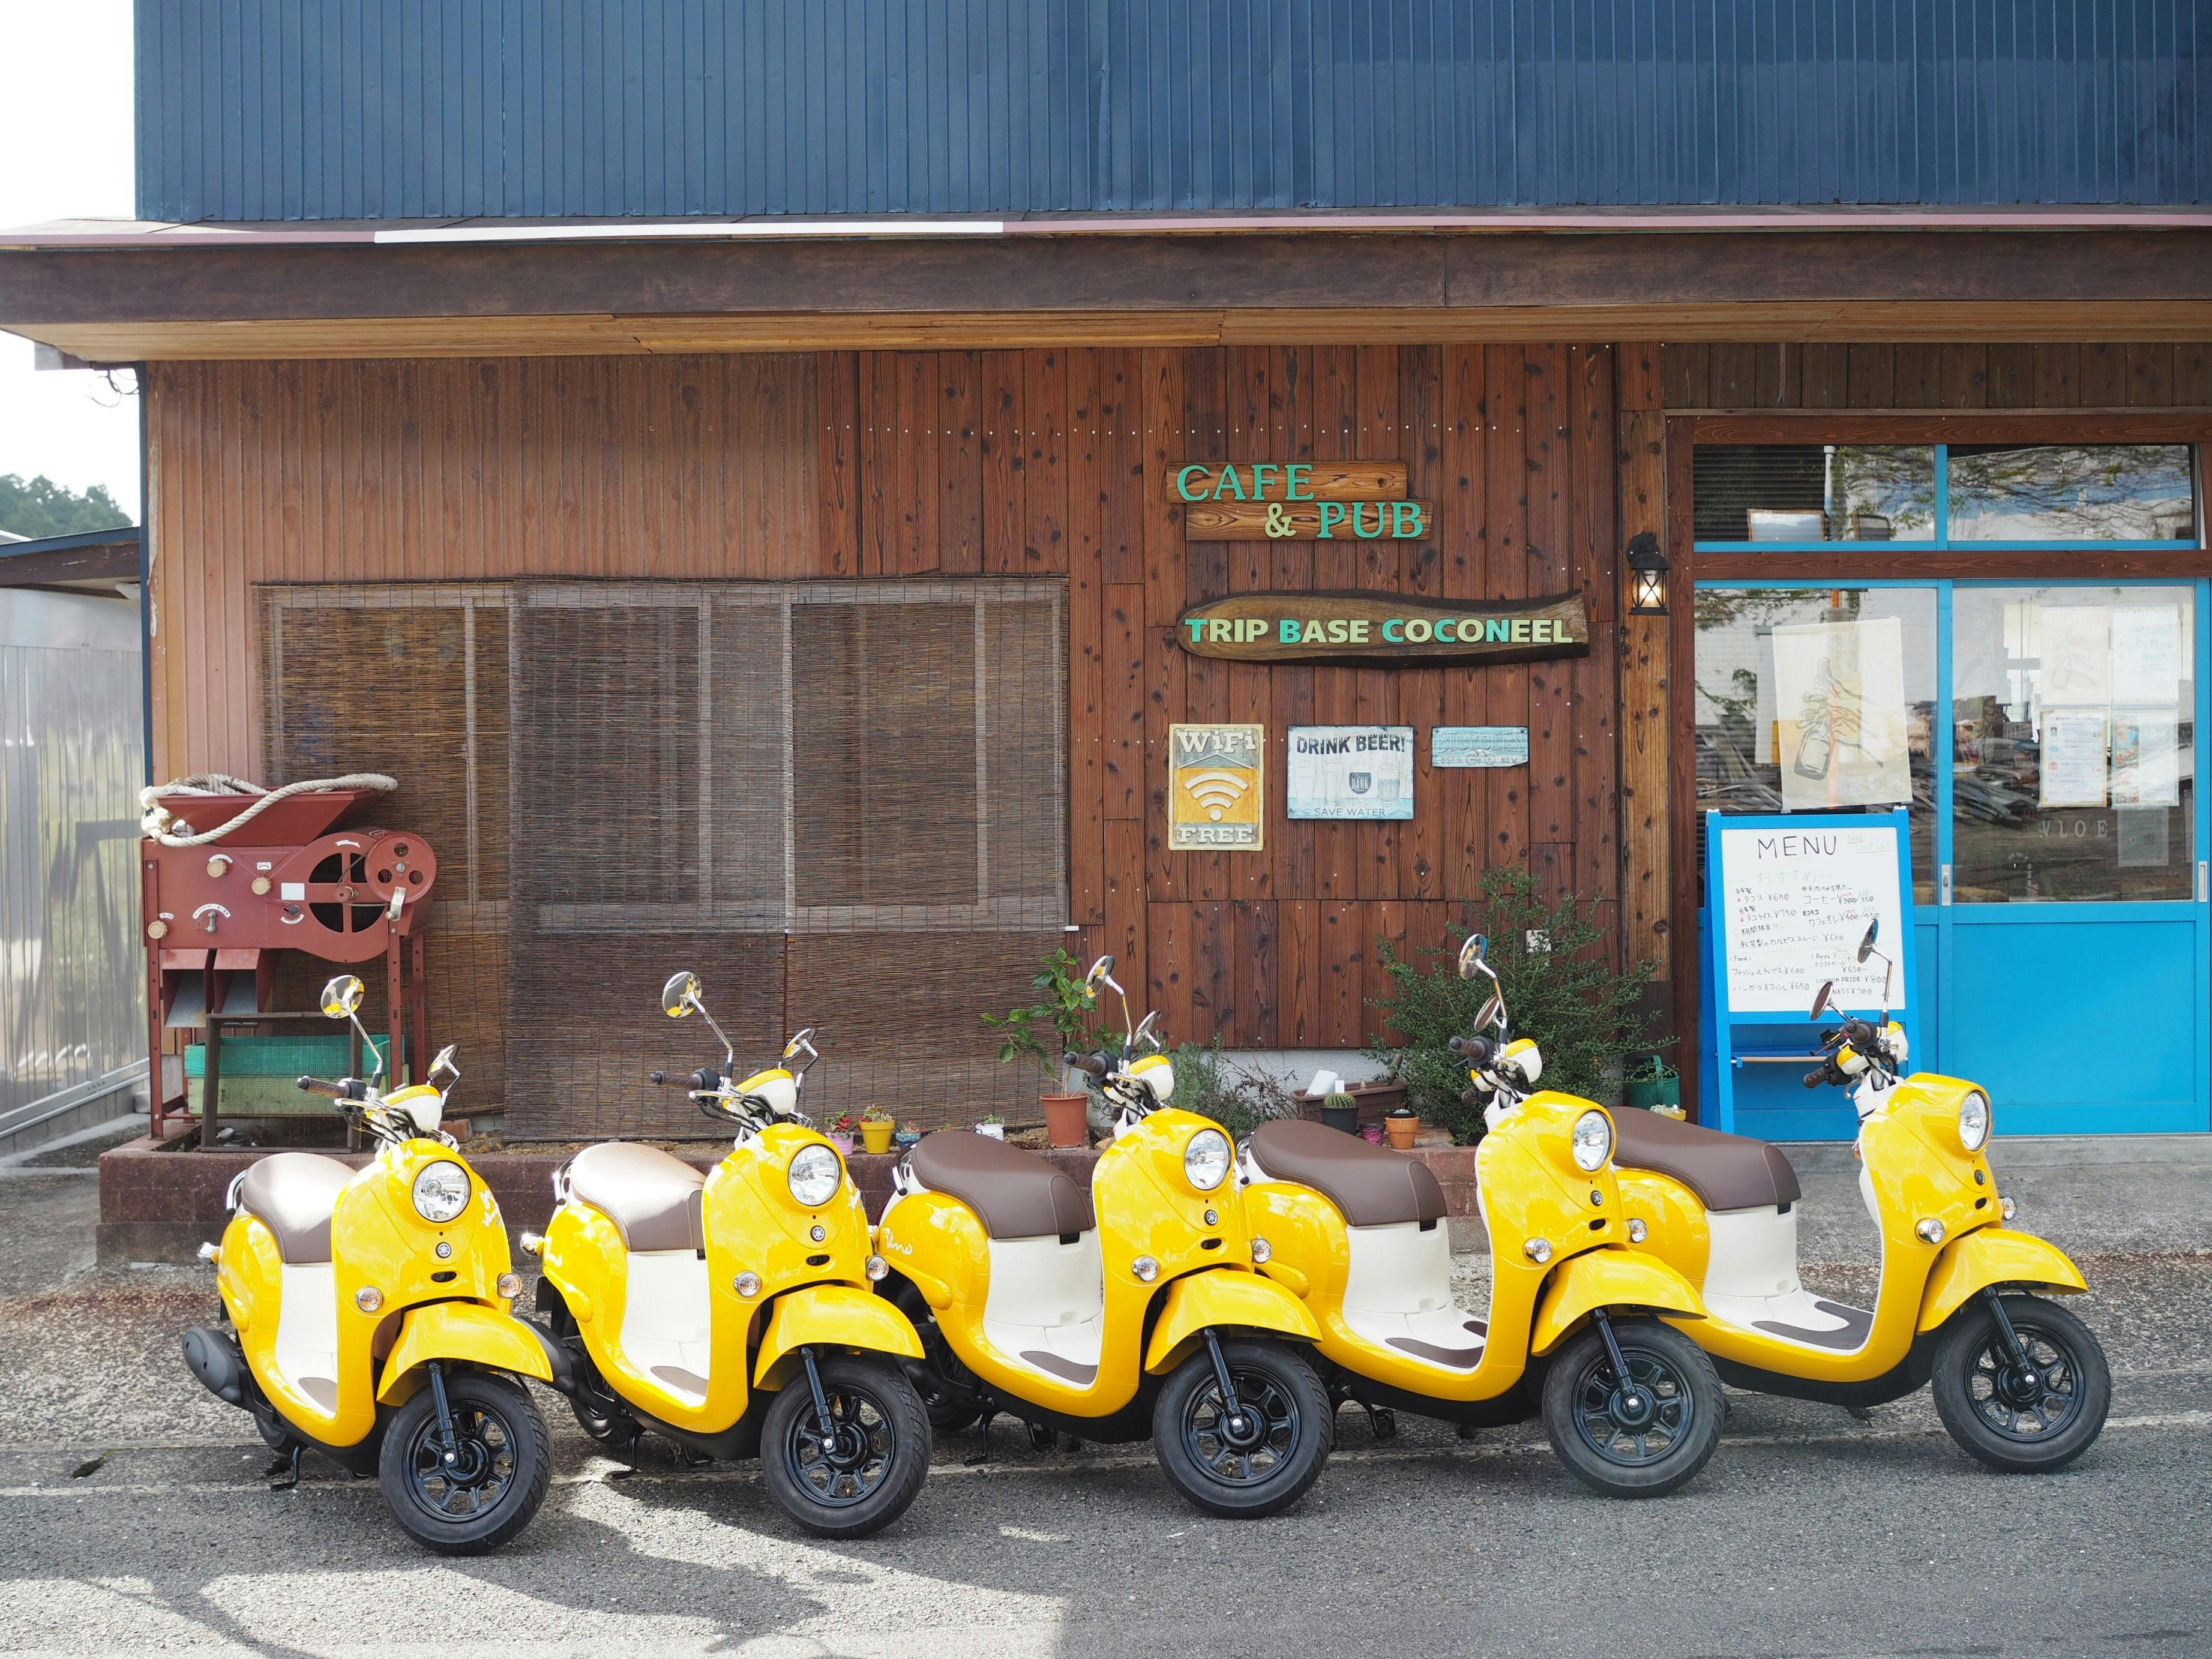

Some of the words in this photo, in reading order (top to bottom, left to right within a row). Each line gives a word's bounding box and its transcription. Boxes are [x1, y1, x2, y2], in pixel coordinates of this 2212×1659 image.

[1176, 464, 1314, 502] CAFE
[1264, 503, 1296, 538] &
[1316, 502, 1424, 539] PUB
[1184, 619, 1269, 643] TRIP
[1279, 619, 1369, 643] BASE
[1381, 619, 1573, 644] COCONEEL
[1176, 730, 1256, 753] WiFi
[1297, 736, 1350, 754] DRINK
[1356, 734, 1405, 752] BEER!
[1438, 730, 1525, 754] BICYCLES
[1351, 778, 1369, 790] DARK
[1179, 827, 1253, 843] FREE
[1758, 835, 1837, 859] MENU
[1743, 895, 1765, 903] タコス
[1803, 895, 1836, 905] コーヒー
[1746, 911, 1772, 922] タコライス
